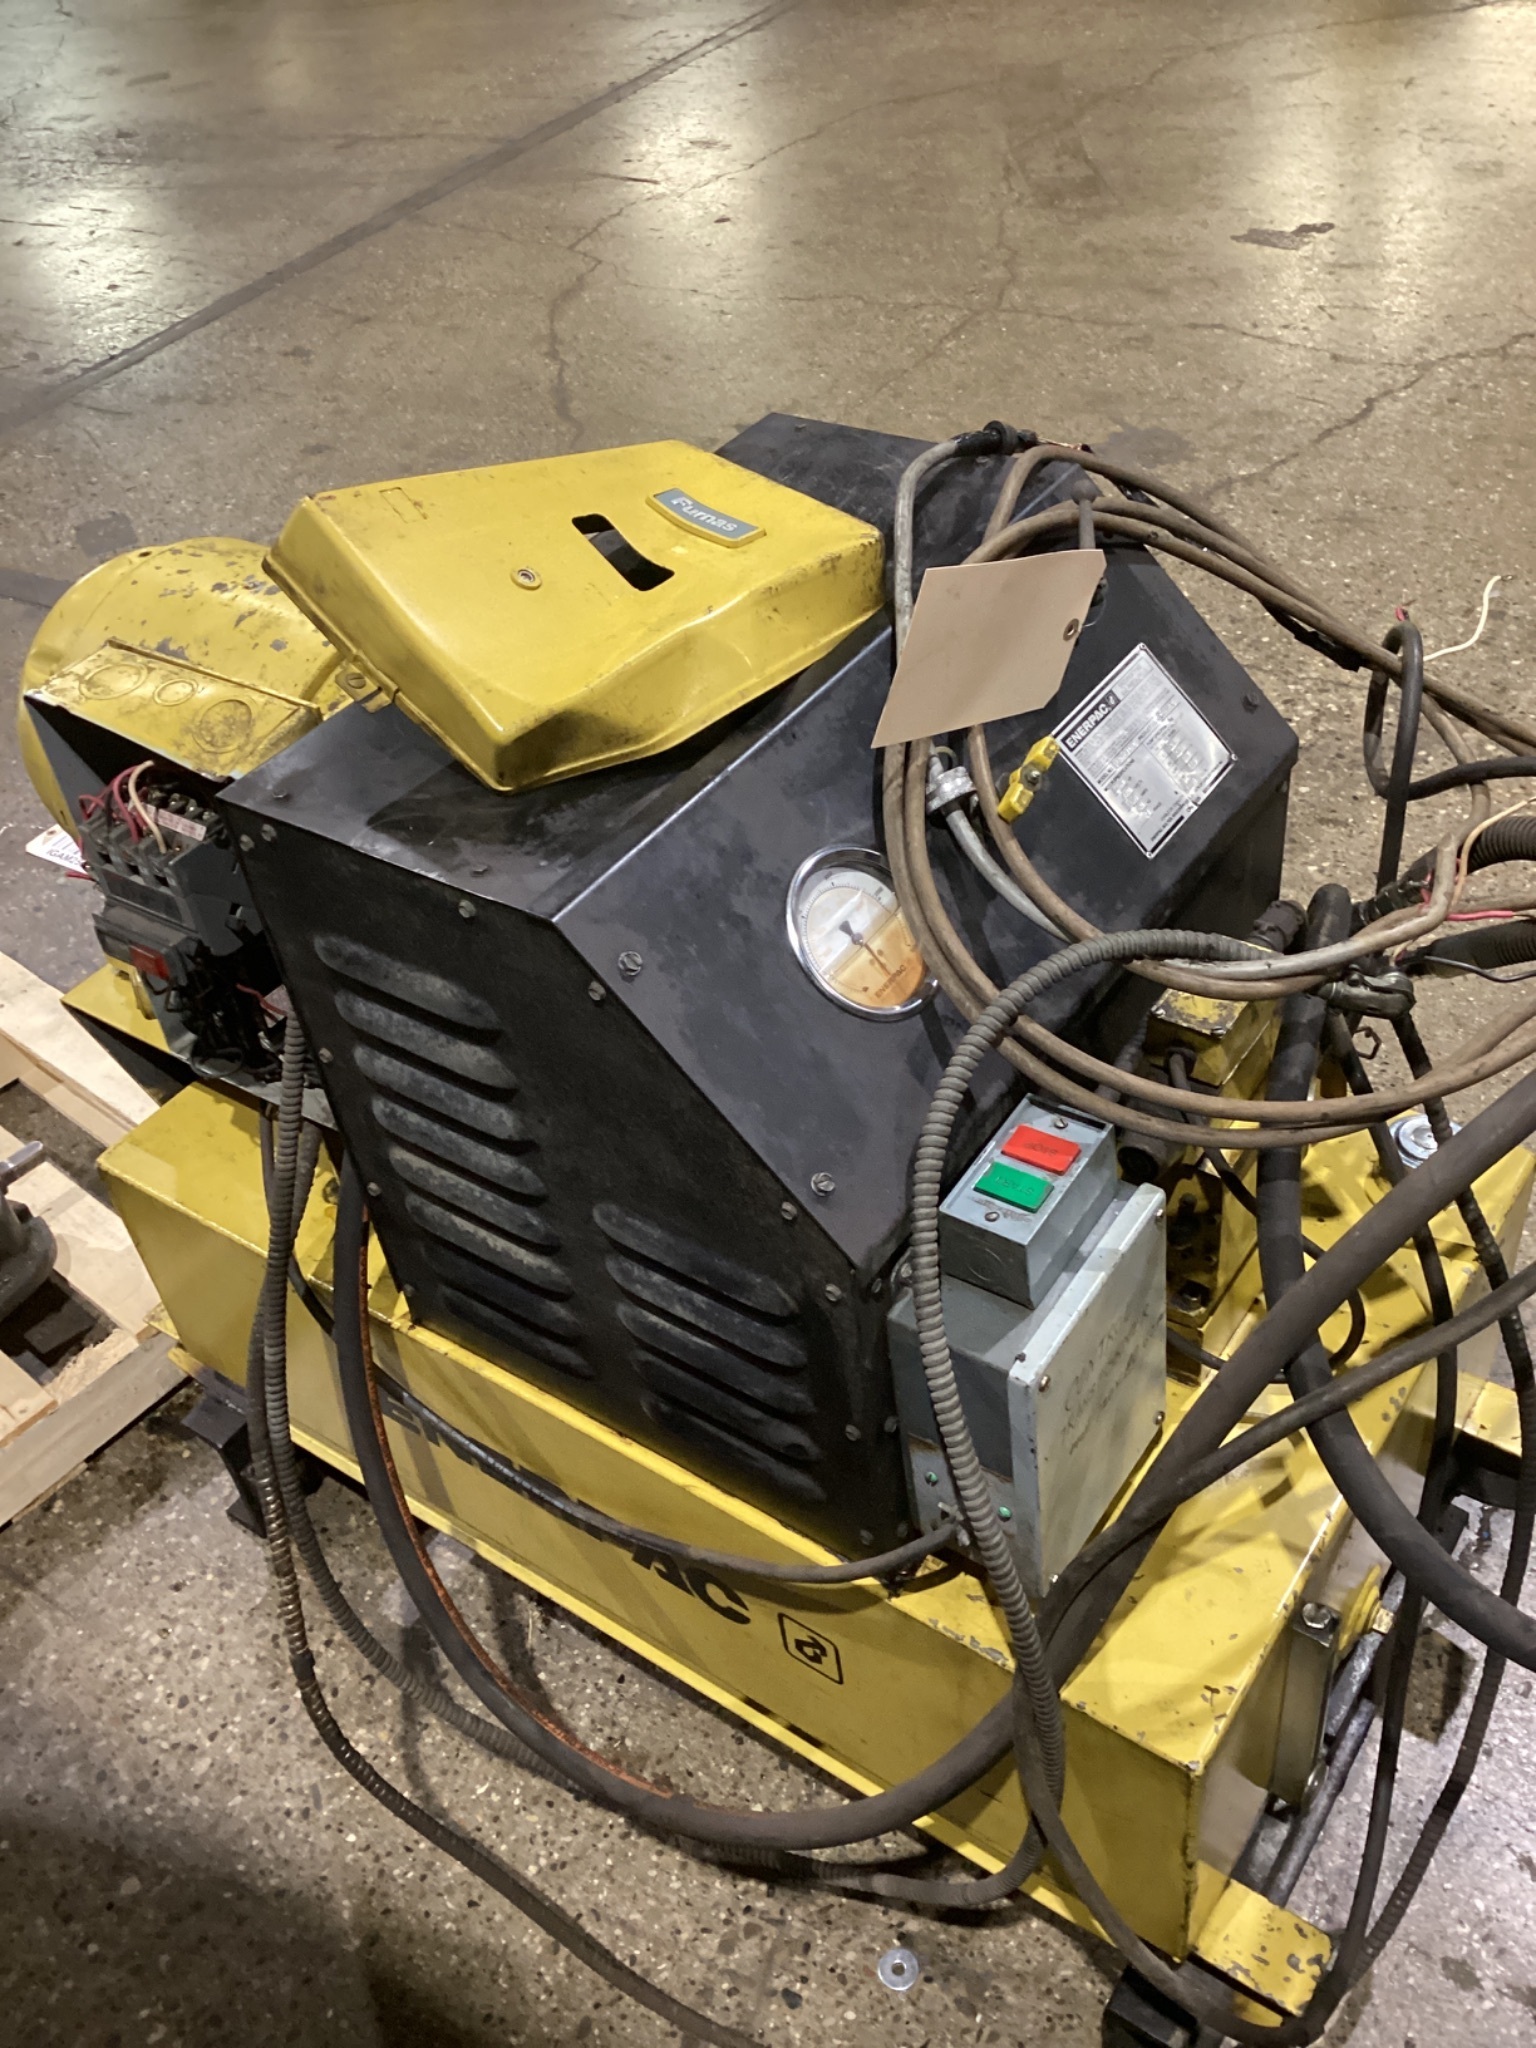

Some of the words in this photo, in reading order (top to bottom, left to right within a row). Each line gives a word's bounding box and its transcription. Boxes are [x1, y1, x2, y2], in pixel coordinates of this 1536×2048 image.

[671, 496, 738, 532] Furnas
[1065, 701, 1110, 750] ENERPAC
[875, 964, 906, 998] ENERPAC
